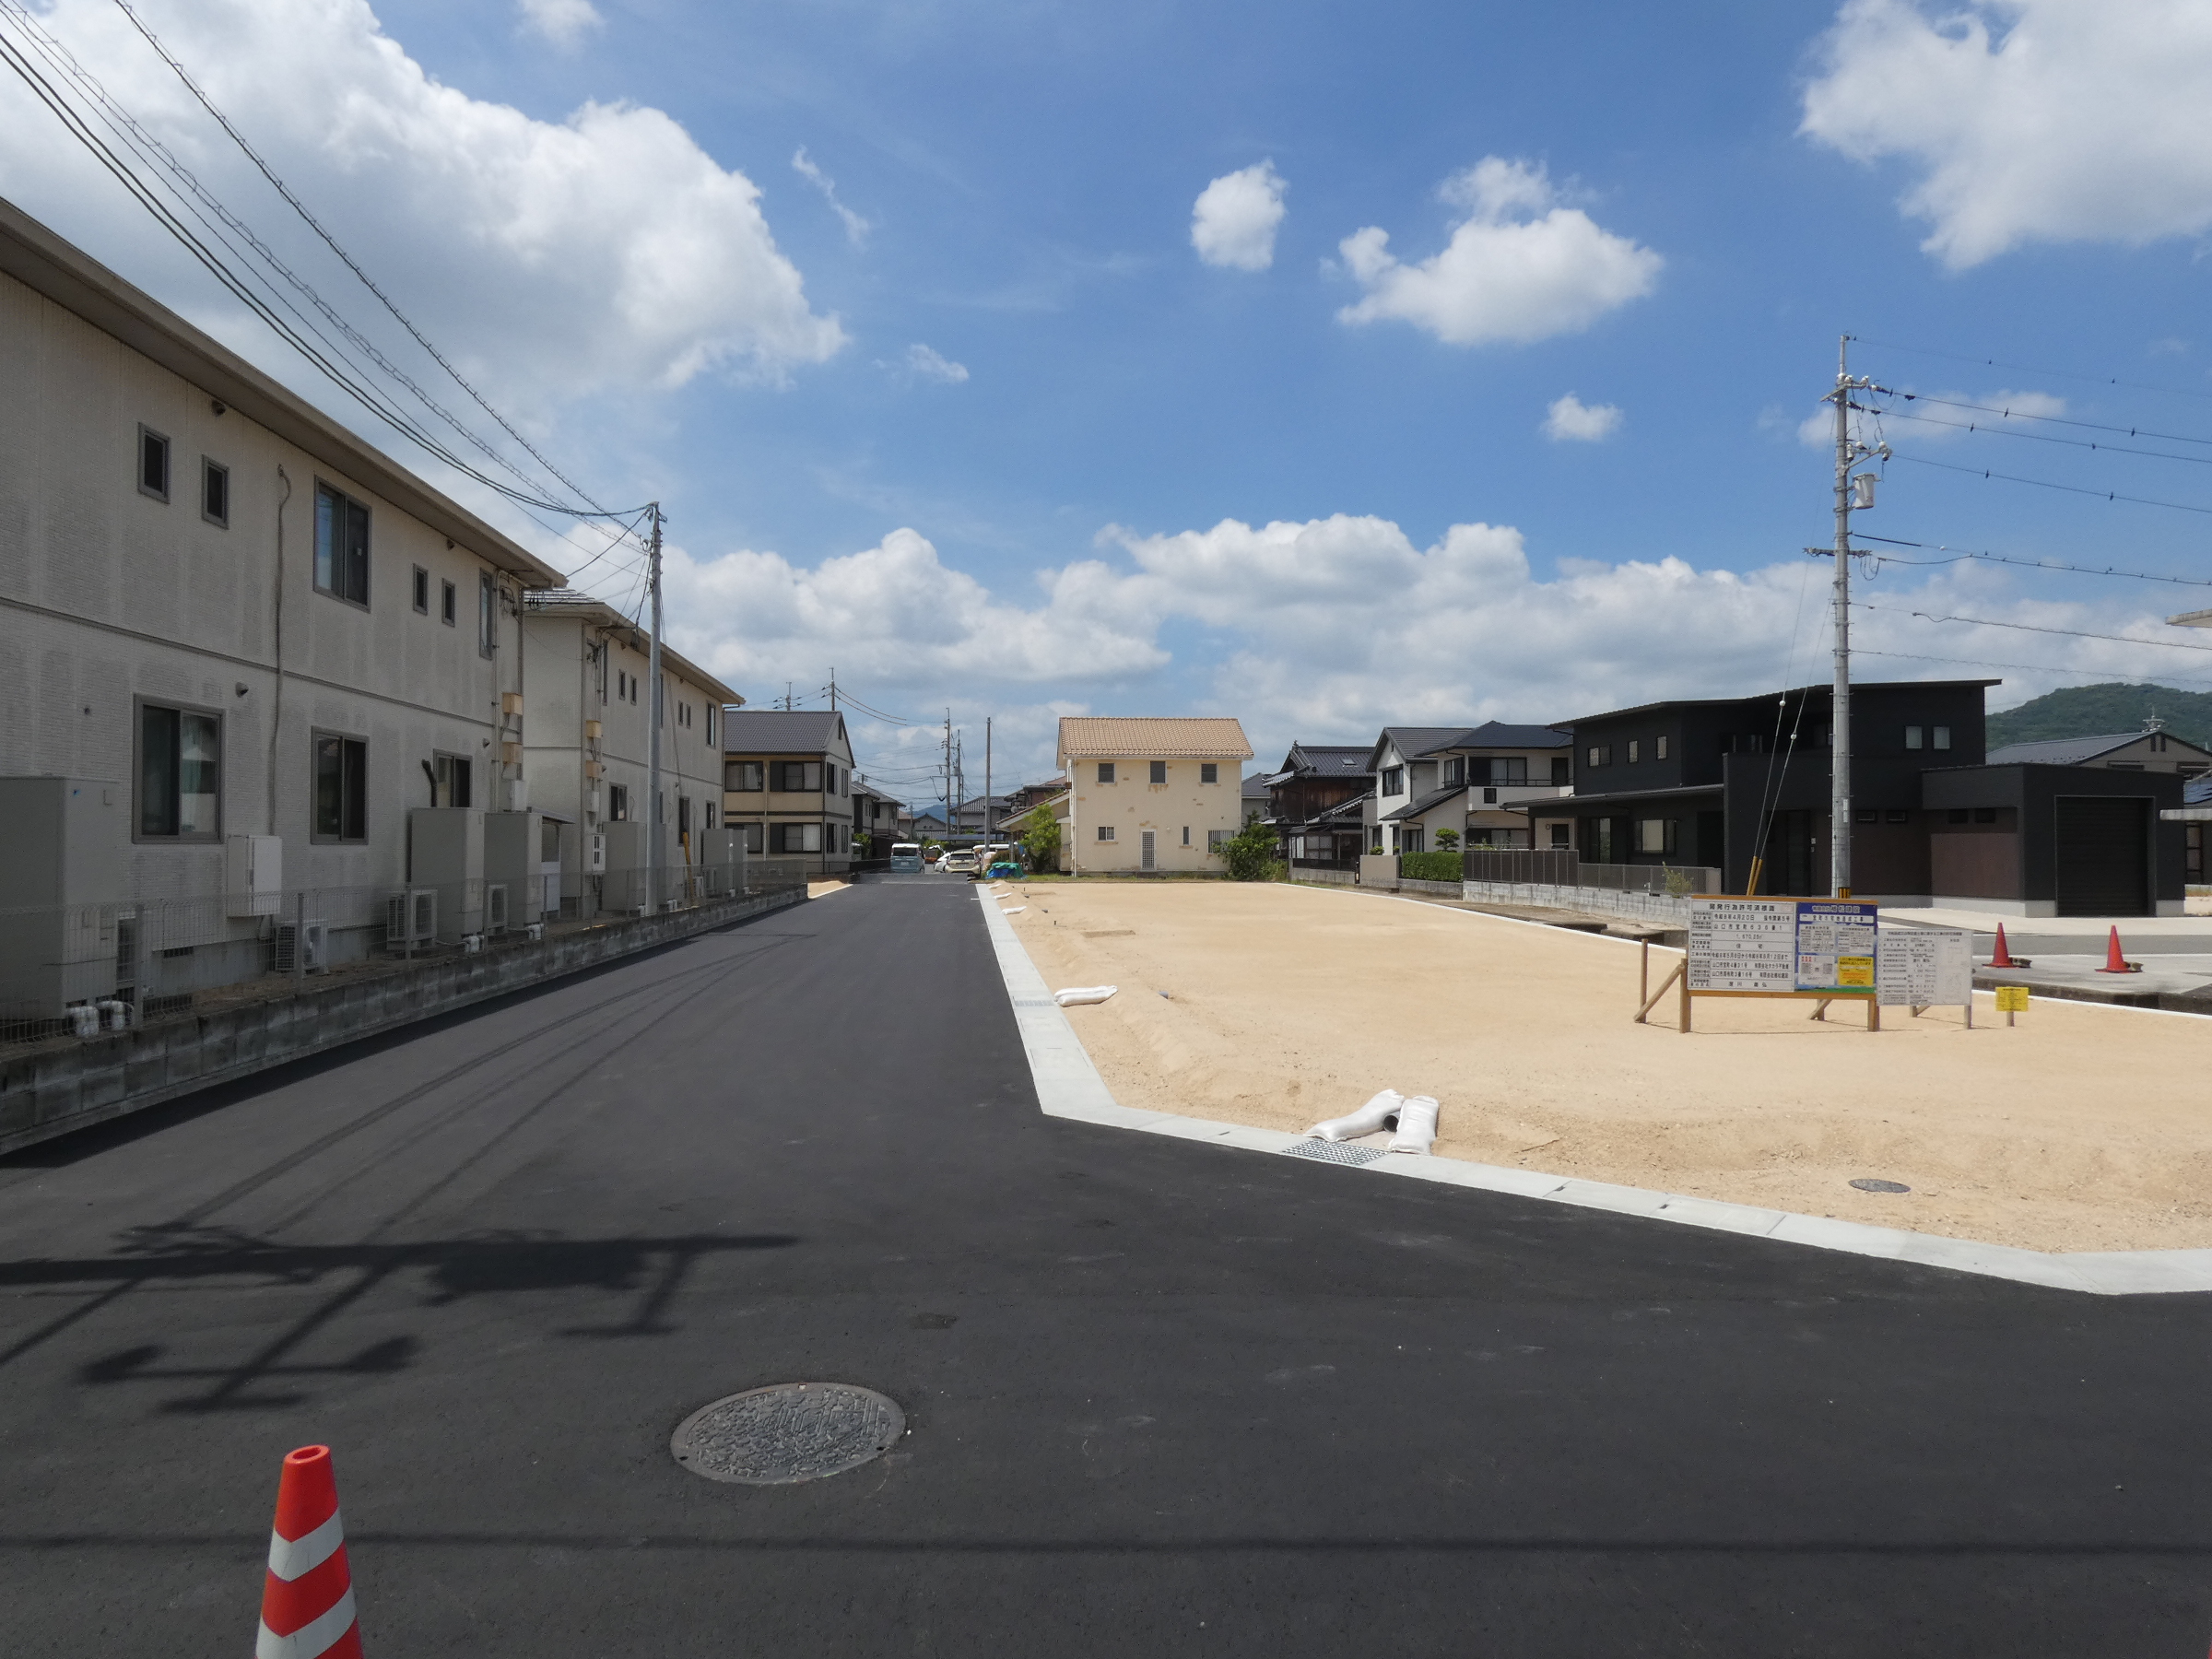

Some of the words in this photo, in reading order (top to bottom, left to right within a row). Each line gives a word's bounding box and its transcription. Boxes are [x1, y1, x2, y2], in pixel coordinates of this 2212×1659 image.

[1709, 903, 1775, 912] 開発行為許可済標識
